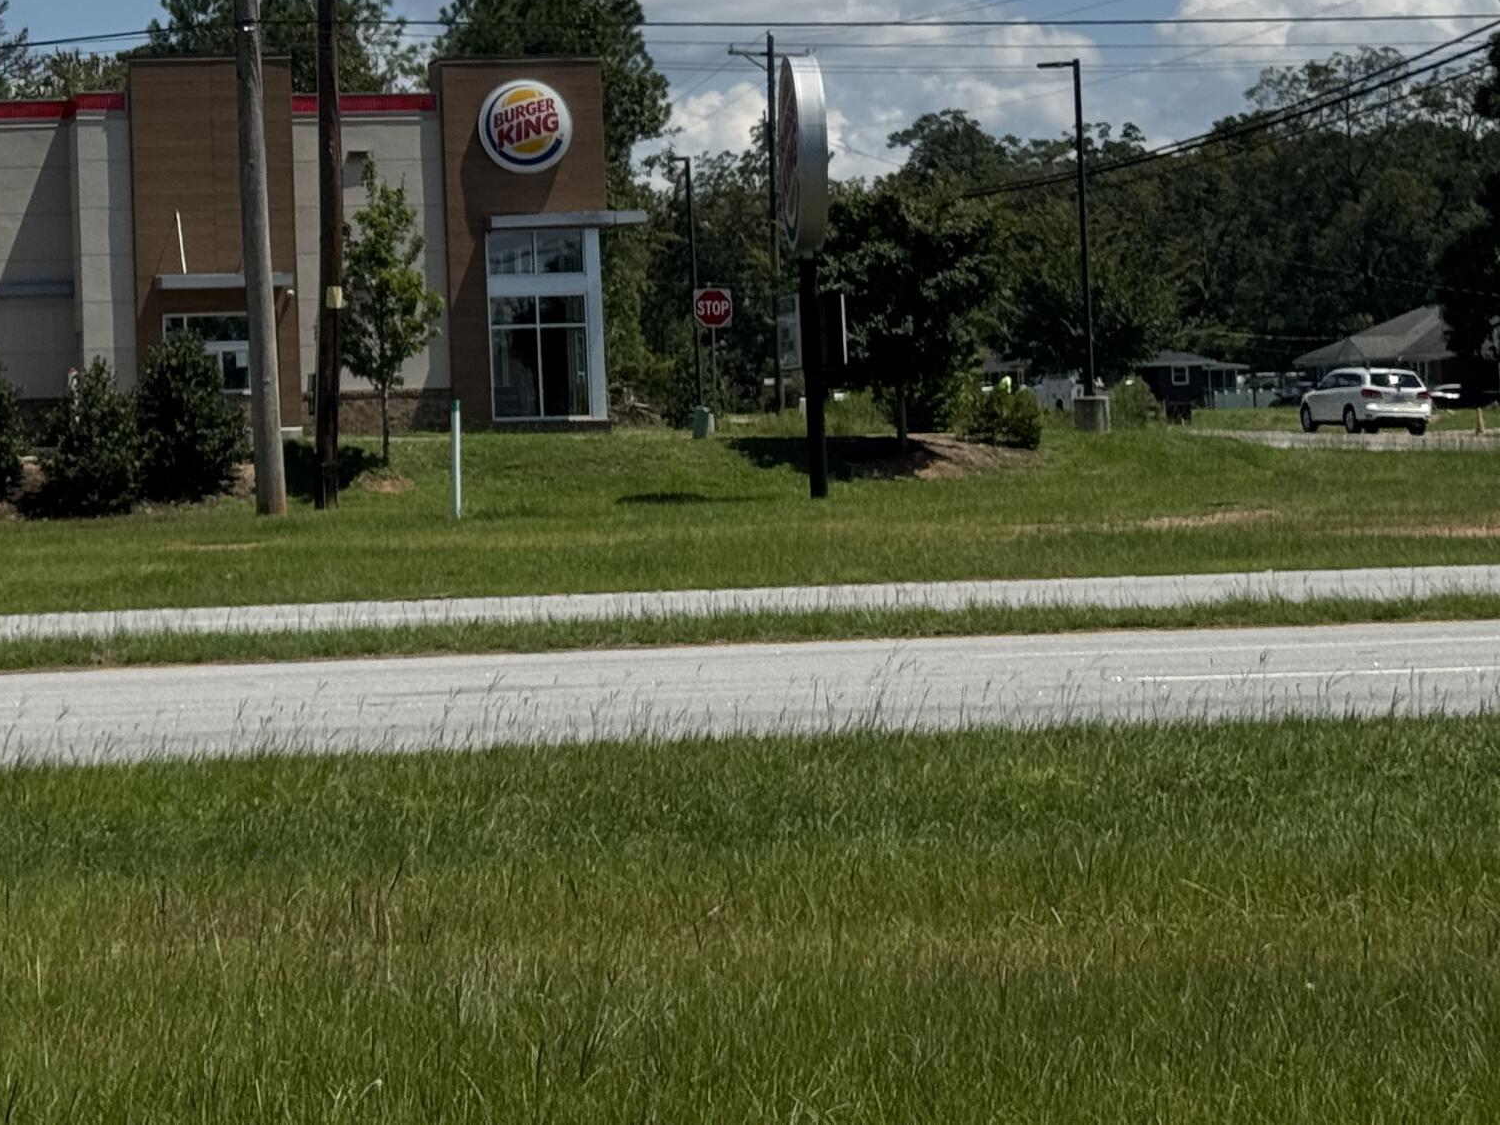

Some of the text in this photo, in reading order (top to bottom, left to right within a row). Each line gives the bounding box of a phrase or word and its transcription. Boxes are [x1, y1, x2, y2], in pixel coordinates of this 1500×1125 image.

[494, 98, 556, 128] BURGER
[496, 113, 559, 149] KING
[697, 300, 730, 316] STOP
